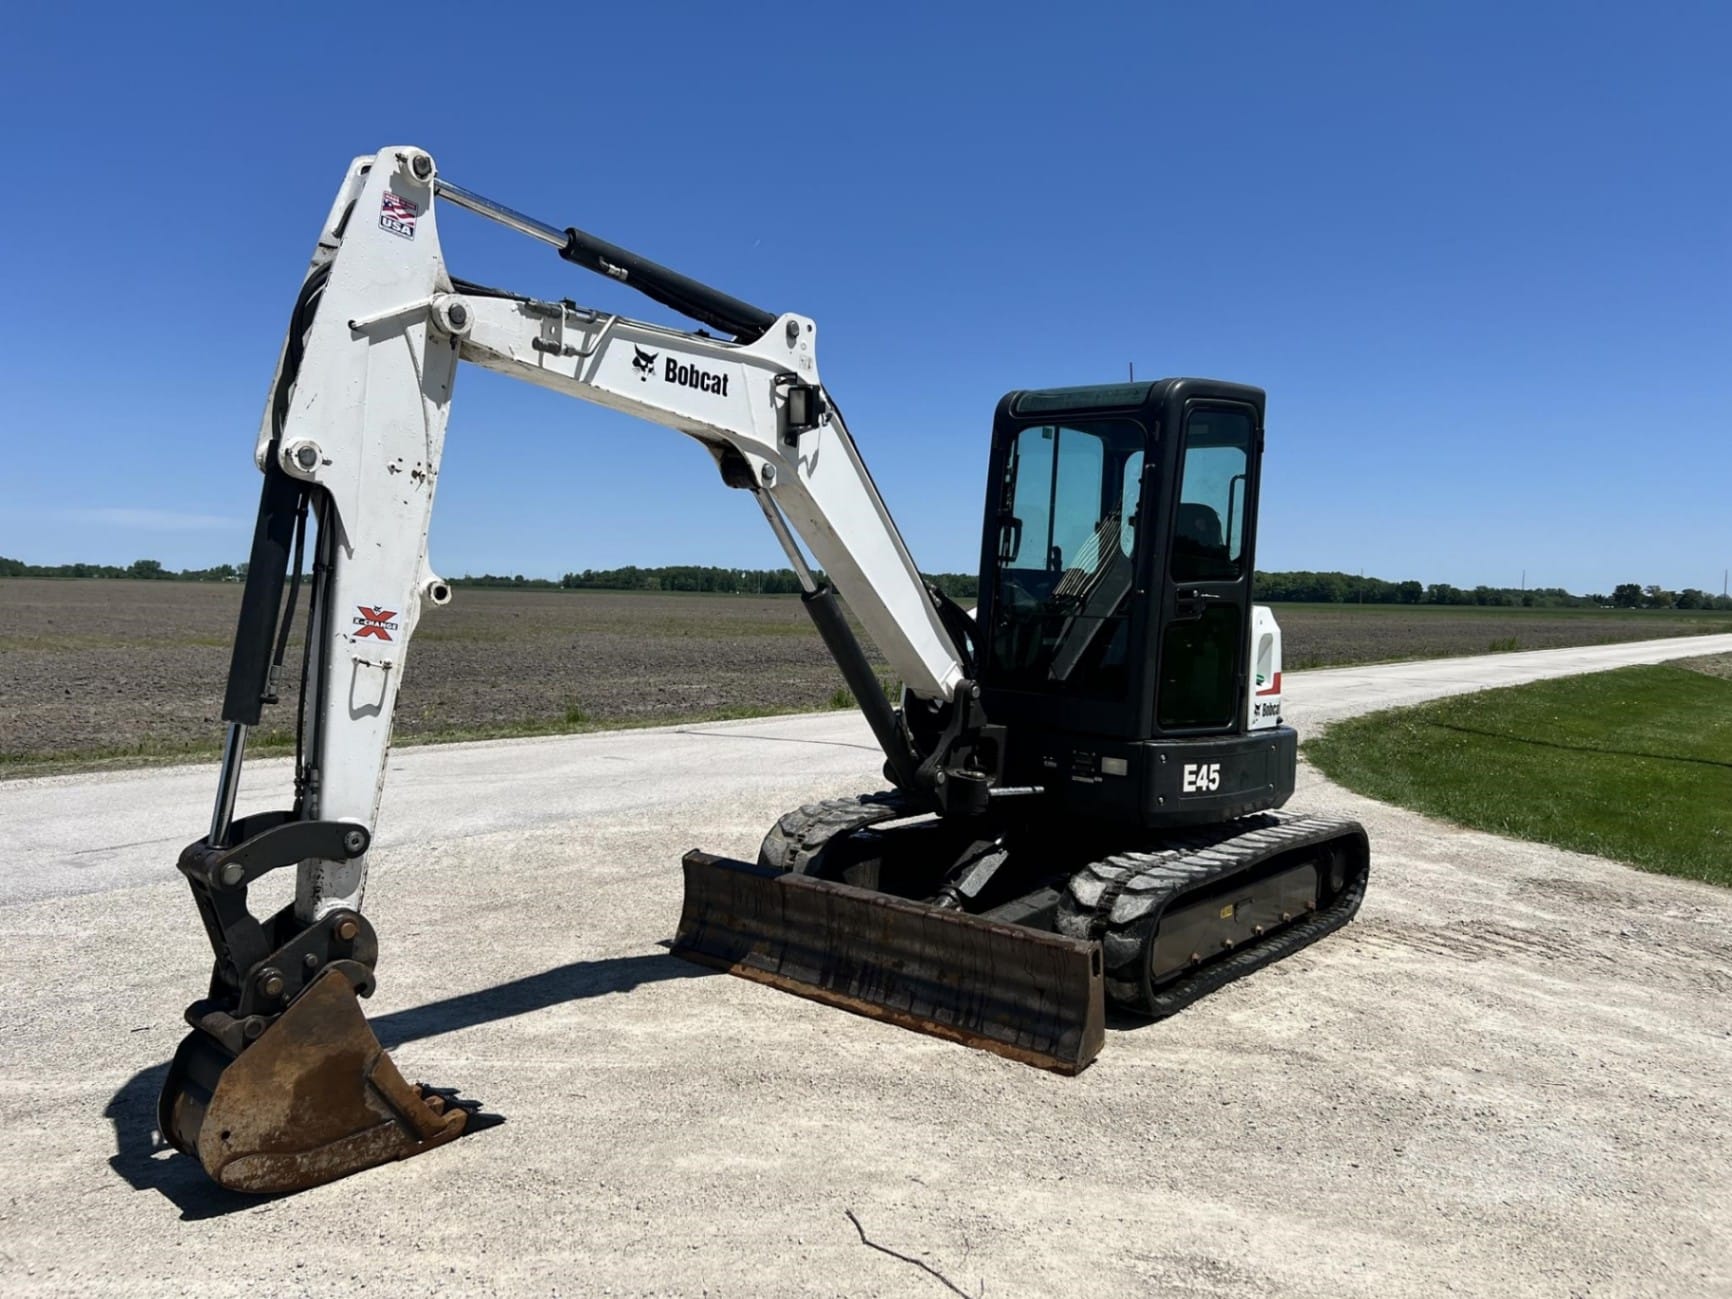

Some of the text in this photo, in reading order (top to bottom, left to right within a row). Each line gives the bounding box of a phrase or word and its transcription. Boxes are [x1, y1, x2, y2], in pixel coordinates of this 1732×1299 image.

[381, 217, 412, 235] USA
[664, 356, 729, 398] Bobcat
[1262, 702, 1280, 717] Bobca
[1183, 763, 1220, 792] E45
